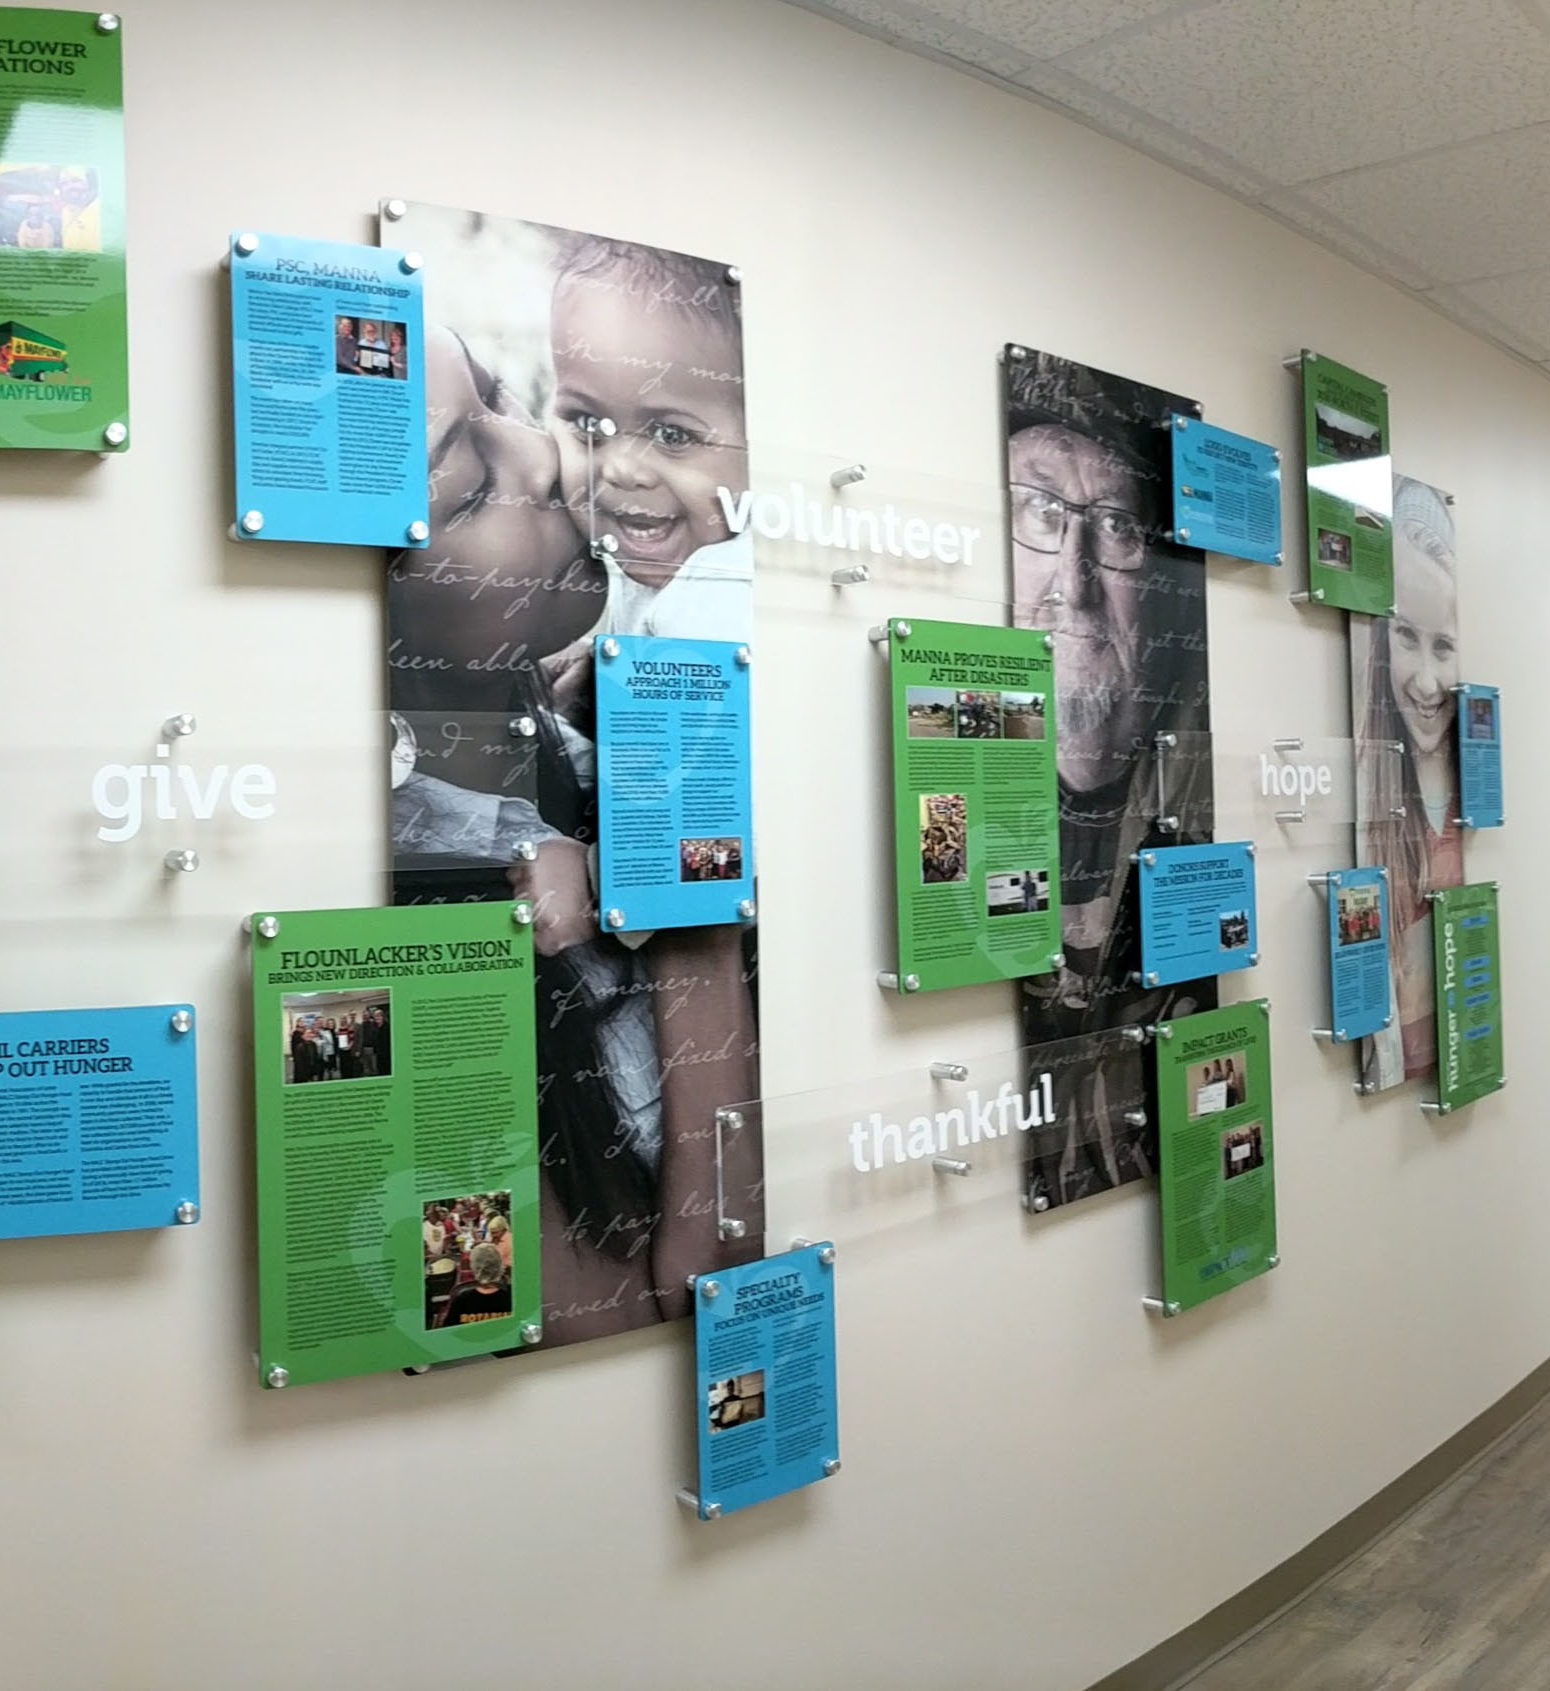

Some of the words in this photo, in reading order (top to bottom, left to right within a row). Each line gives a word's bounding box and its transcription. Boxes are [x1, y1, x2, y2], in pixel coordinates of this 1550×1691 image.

[244, 270, 283, 283] SHARE
[276, 258, 310, 277] PSC,
[313, 262, 382, 283] MANNA
[716, 481, 981, 566] volunteer
[466, 641, 535, 672] able
[632, 660, 722, 678] VOLUNTEERS
[901, 649, 952, 664] MANNA
[954, 653, 998, 668] PROVES
[929, 668, 969, 683] AFTER
[632, 689, 668, 700] HOURS
[669, 690, 683, 700] OF
[685, 691, 725, 702] SERVICE
[92, 743, 278, 842] give
[1259, 753, 1332, 806] hope
[281, 943, 444, 970] FLOUNLACKER'S
[447, 940, 512, 961] VISION
[1444, 922, 1457, 992] hope
[268, 971, 314, 985] BRINGS
[315, 969, 350, 982] NEW
[349, 964, 416, 980] DIRECTION
[426, 957, 525, 975] COLLABORATION
[17, 1038, 110, 1059] CARRIERS
[1448, 1010, 1460, 1094] hunger
[8, 1061, 50, 1078] OUT
[53, 1057, 133, 1076] HUNGER
[848, 1073, 1056, 1172] thankful
[736, 1272, 802, 1300] SPECIALTY
[734, 1285, 805, 1316] PROGRAMS
